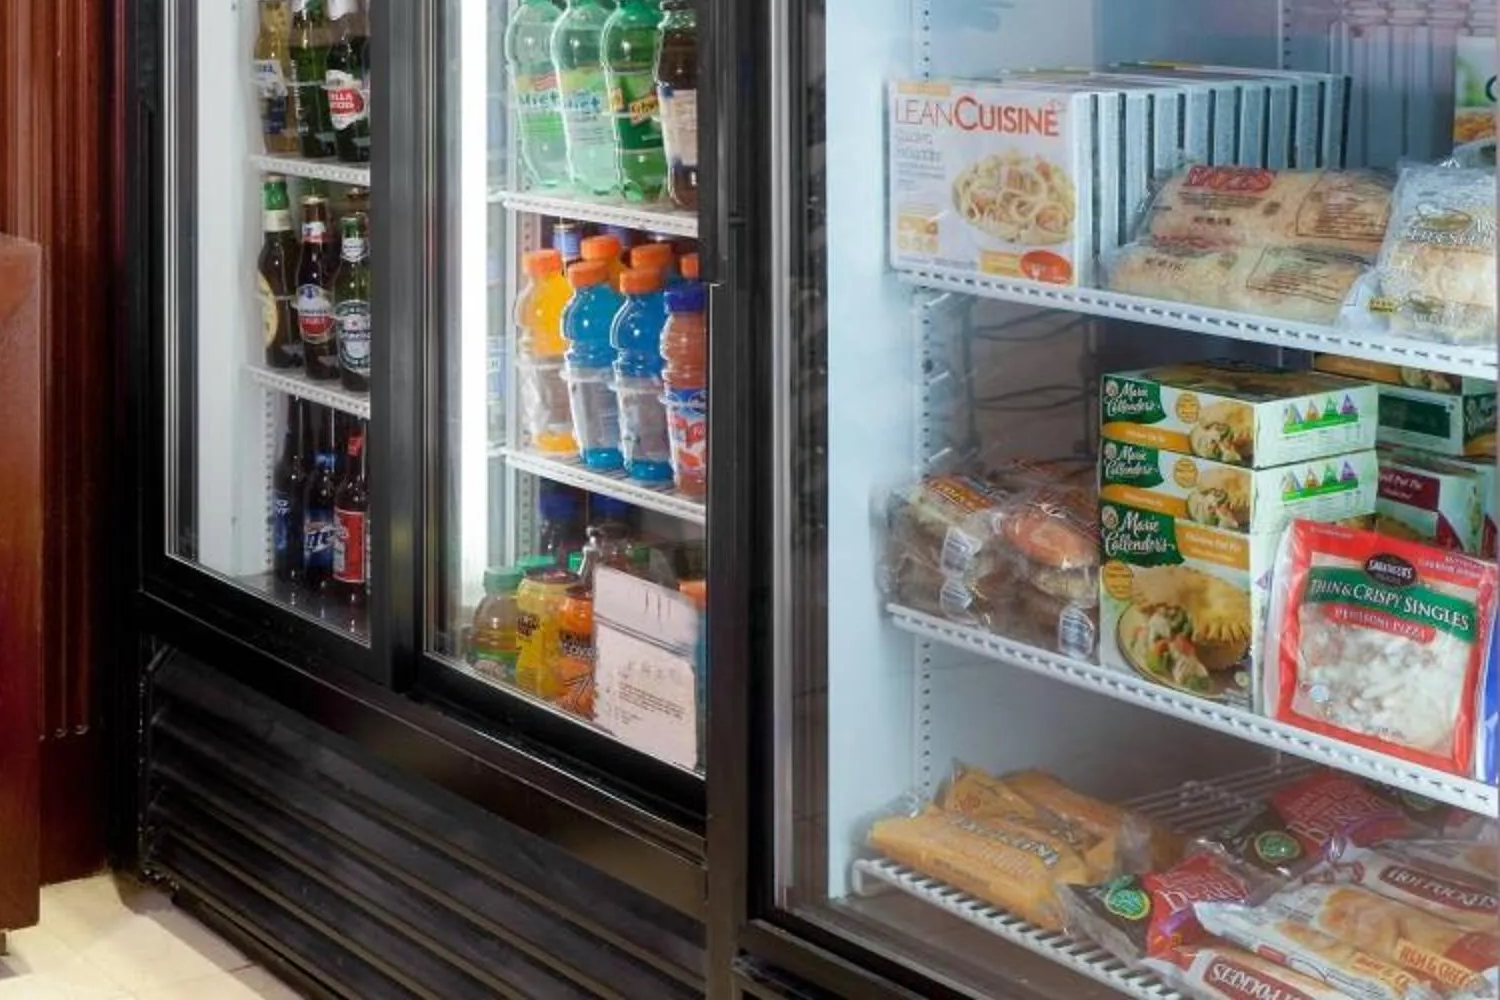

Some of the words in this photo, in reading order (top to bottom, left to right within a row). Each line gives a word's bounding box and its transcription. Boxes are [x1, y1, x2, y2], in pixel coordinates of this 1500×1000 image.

[895, 98, 953, 128] LEAN
[954, 96, 1059, 137] CUISINE
[1353, 583, 1401, 609] CRISPY
[1403, 597, 1470, 631] SINGLES
